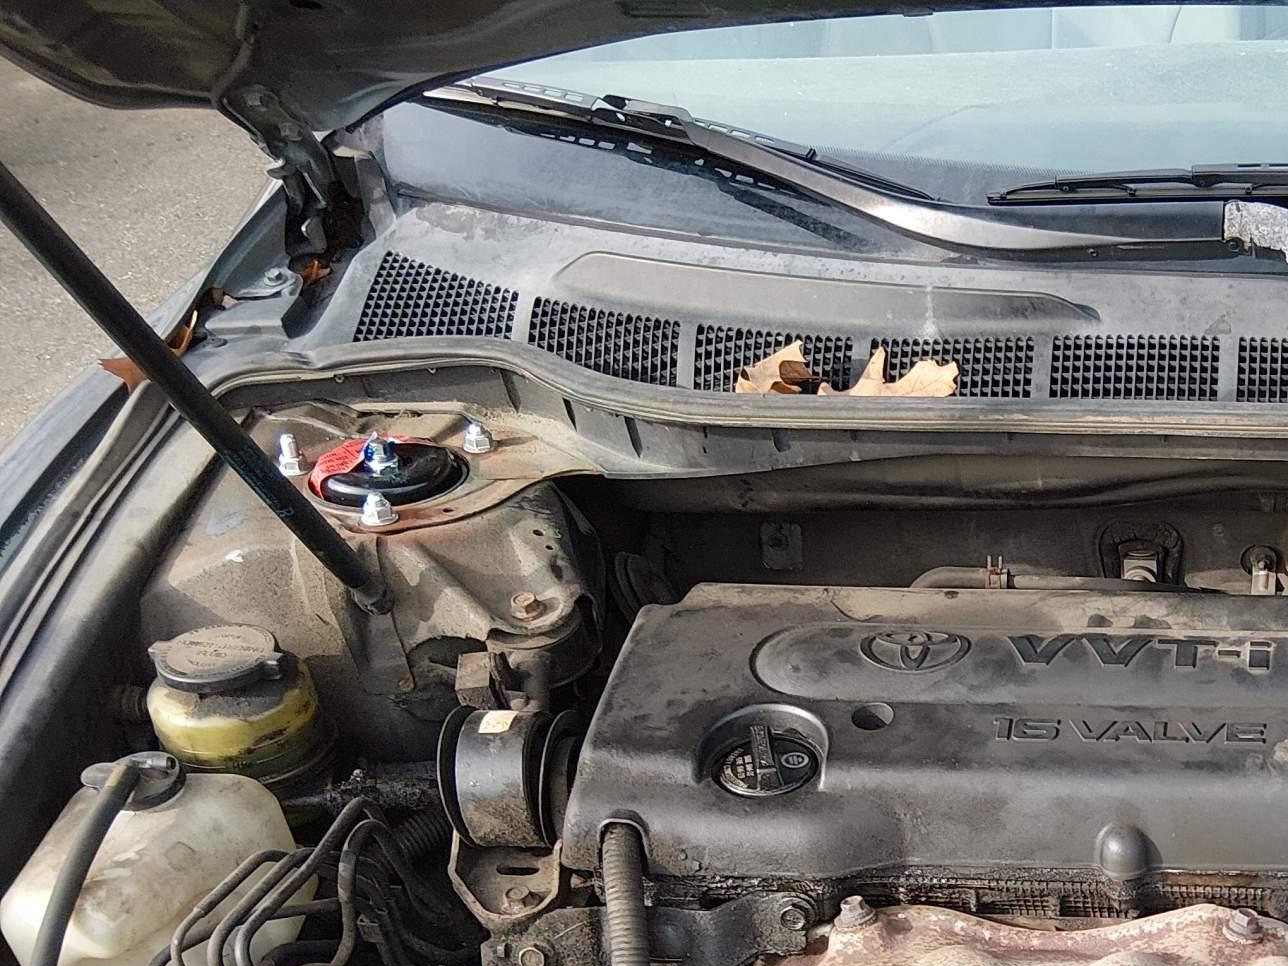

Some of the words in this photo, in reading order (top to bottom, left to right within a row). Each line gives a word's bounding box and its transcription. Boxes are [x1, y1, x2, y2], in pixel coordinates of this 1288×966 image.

[1006, 634, 1271, 670] VVT-i
[993, 716, 1062, 742] 16
[1069, 719, 1268, 744] VALVE
